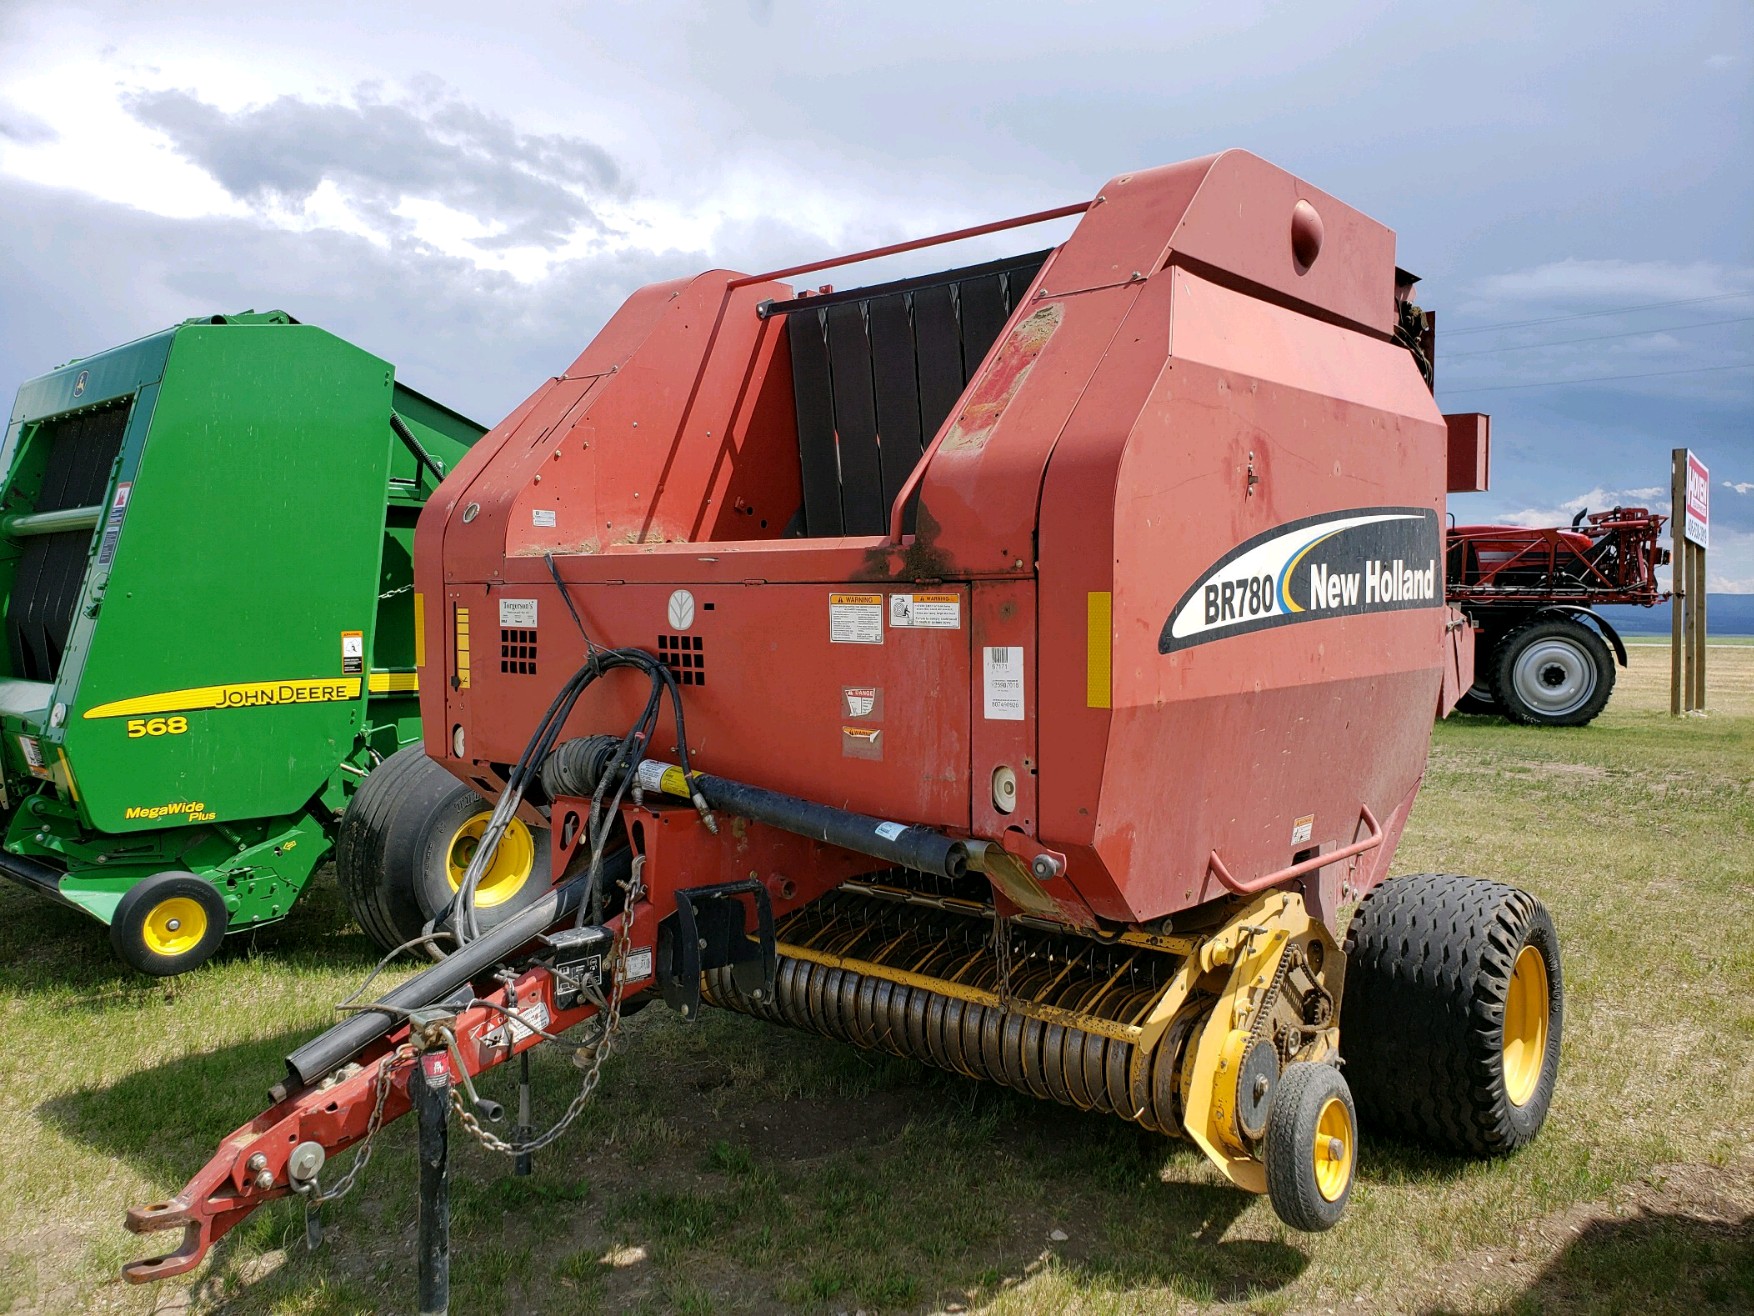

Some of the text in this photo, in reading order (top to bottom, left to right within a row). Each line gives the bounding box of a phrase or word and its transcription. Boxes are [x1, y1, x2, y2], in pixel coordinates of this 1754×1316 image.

[1310, 559, 1435, 610] New Holland
[1204, 574, 1274, 625] BR780
[216, 685, 347, 705] JOHN DEERE
[127, 716, 188, 738] 568
[125, 801, 205, 819] MegaWide
[188, 812, 217, 822] Plus
